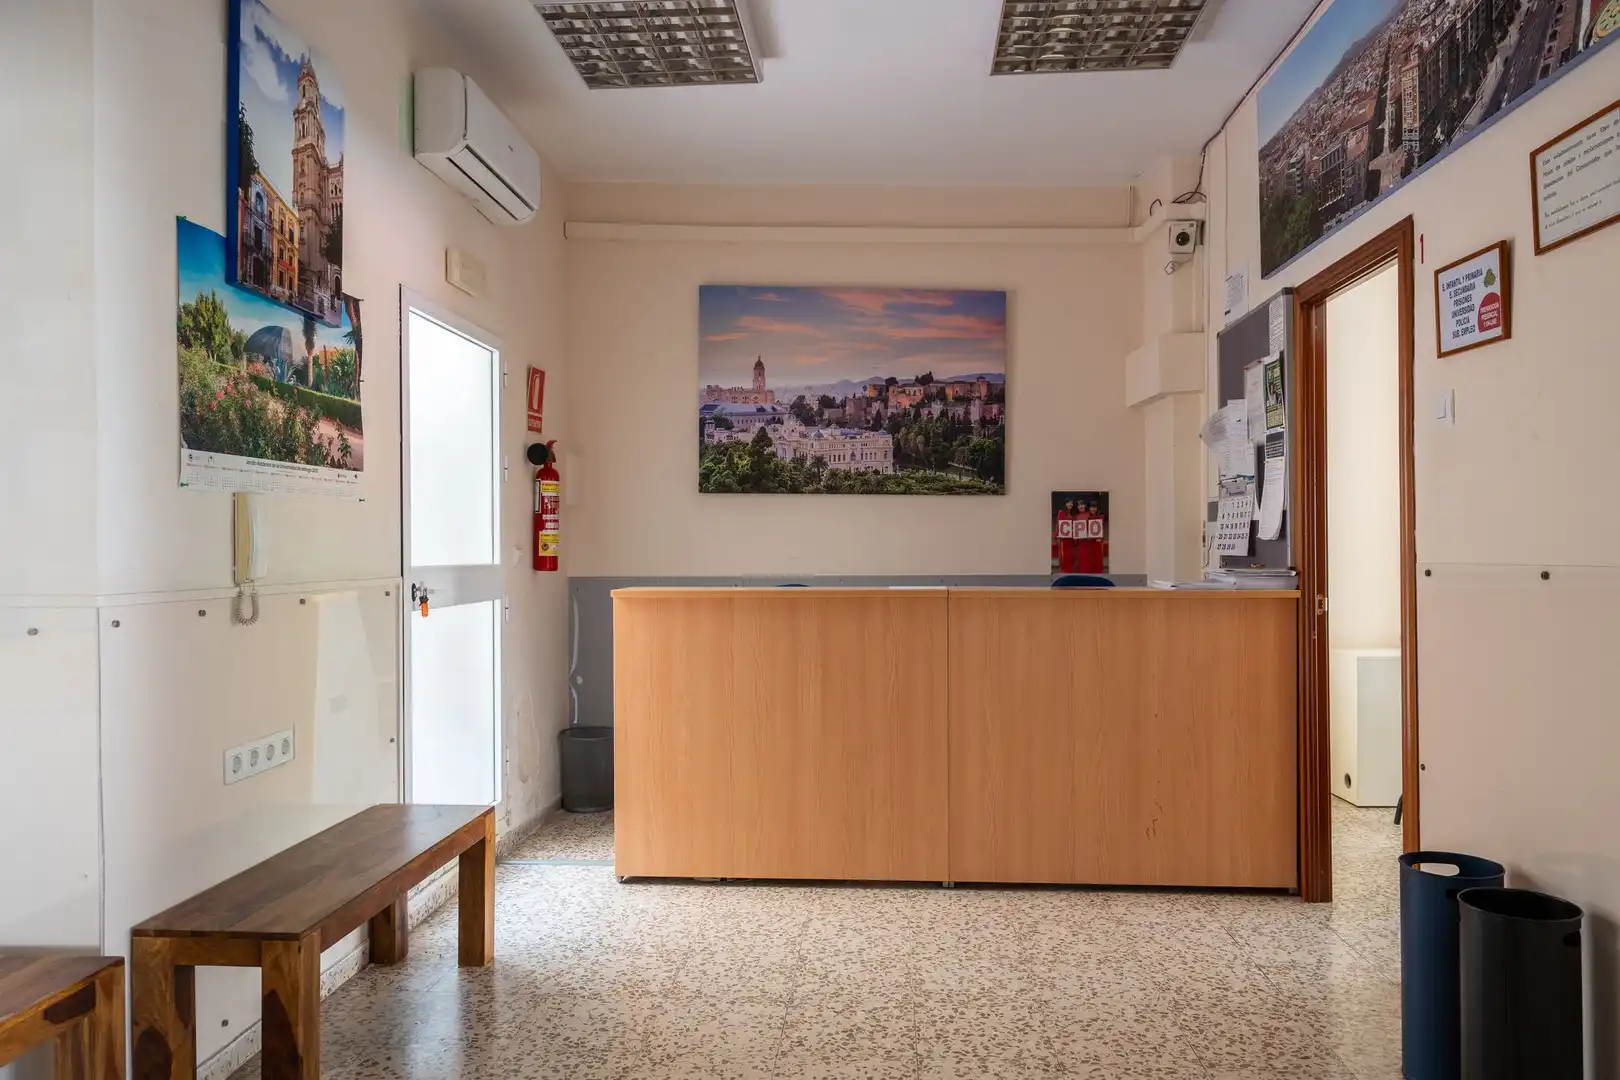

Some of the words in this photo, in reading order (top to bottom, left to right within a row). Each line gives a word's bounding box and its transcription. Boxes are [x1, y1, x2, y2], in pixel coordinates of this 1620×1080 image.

[1446, 278, 1462, 290] INFANTIL
[1465, 268, 1483, 280] PRIMARIA
[1454, 282, 1476, 298] SECUNDARIA
[1454, 294, 1472, 308] PRISIONES
[1451, 304, 1475, 318] UNIVERSIDAD
[1461, 325, 1475, 337] EMPLEO
[1060, 520, 1101, 538] CPO
